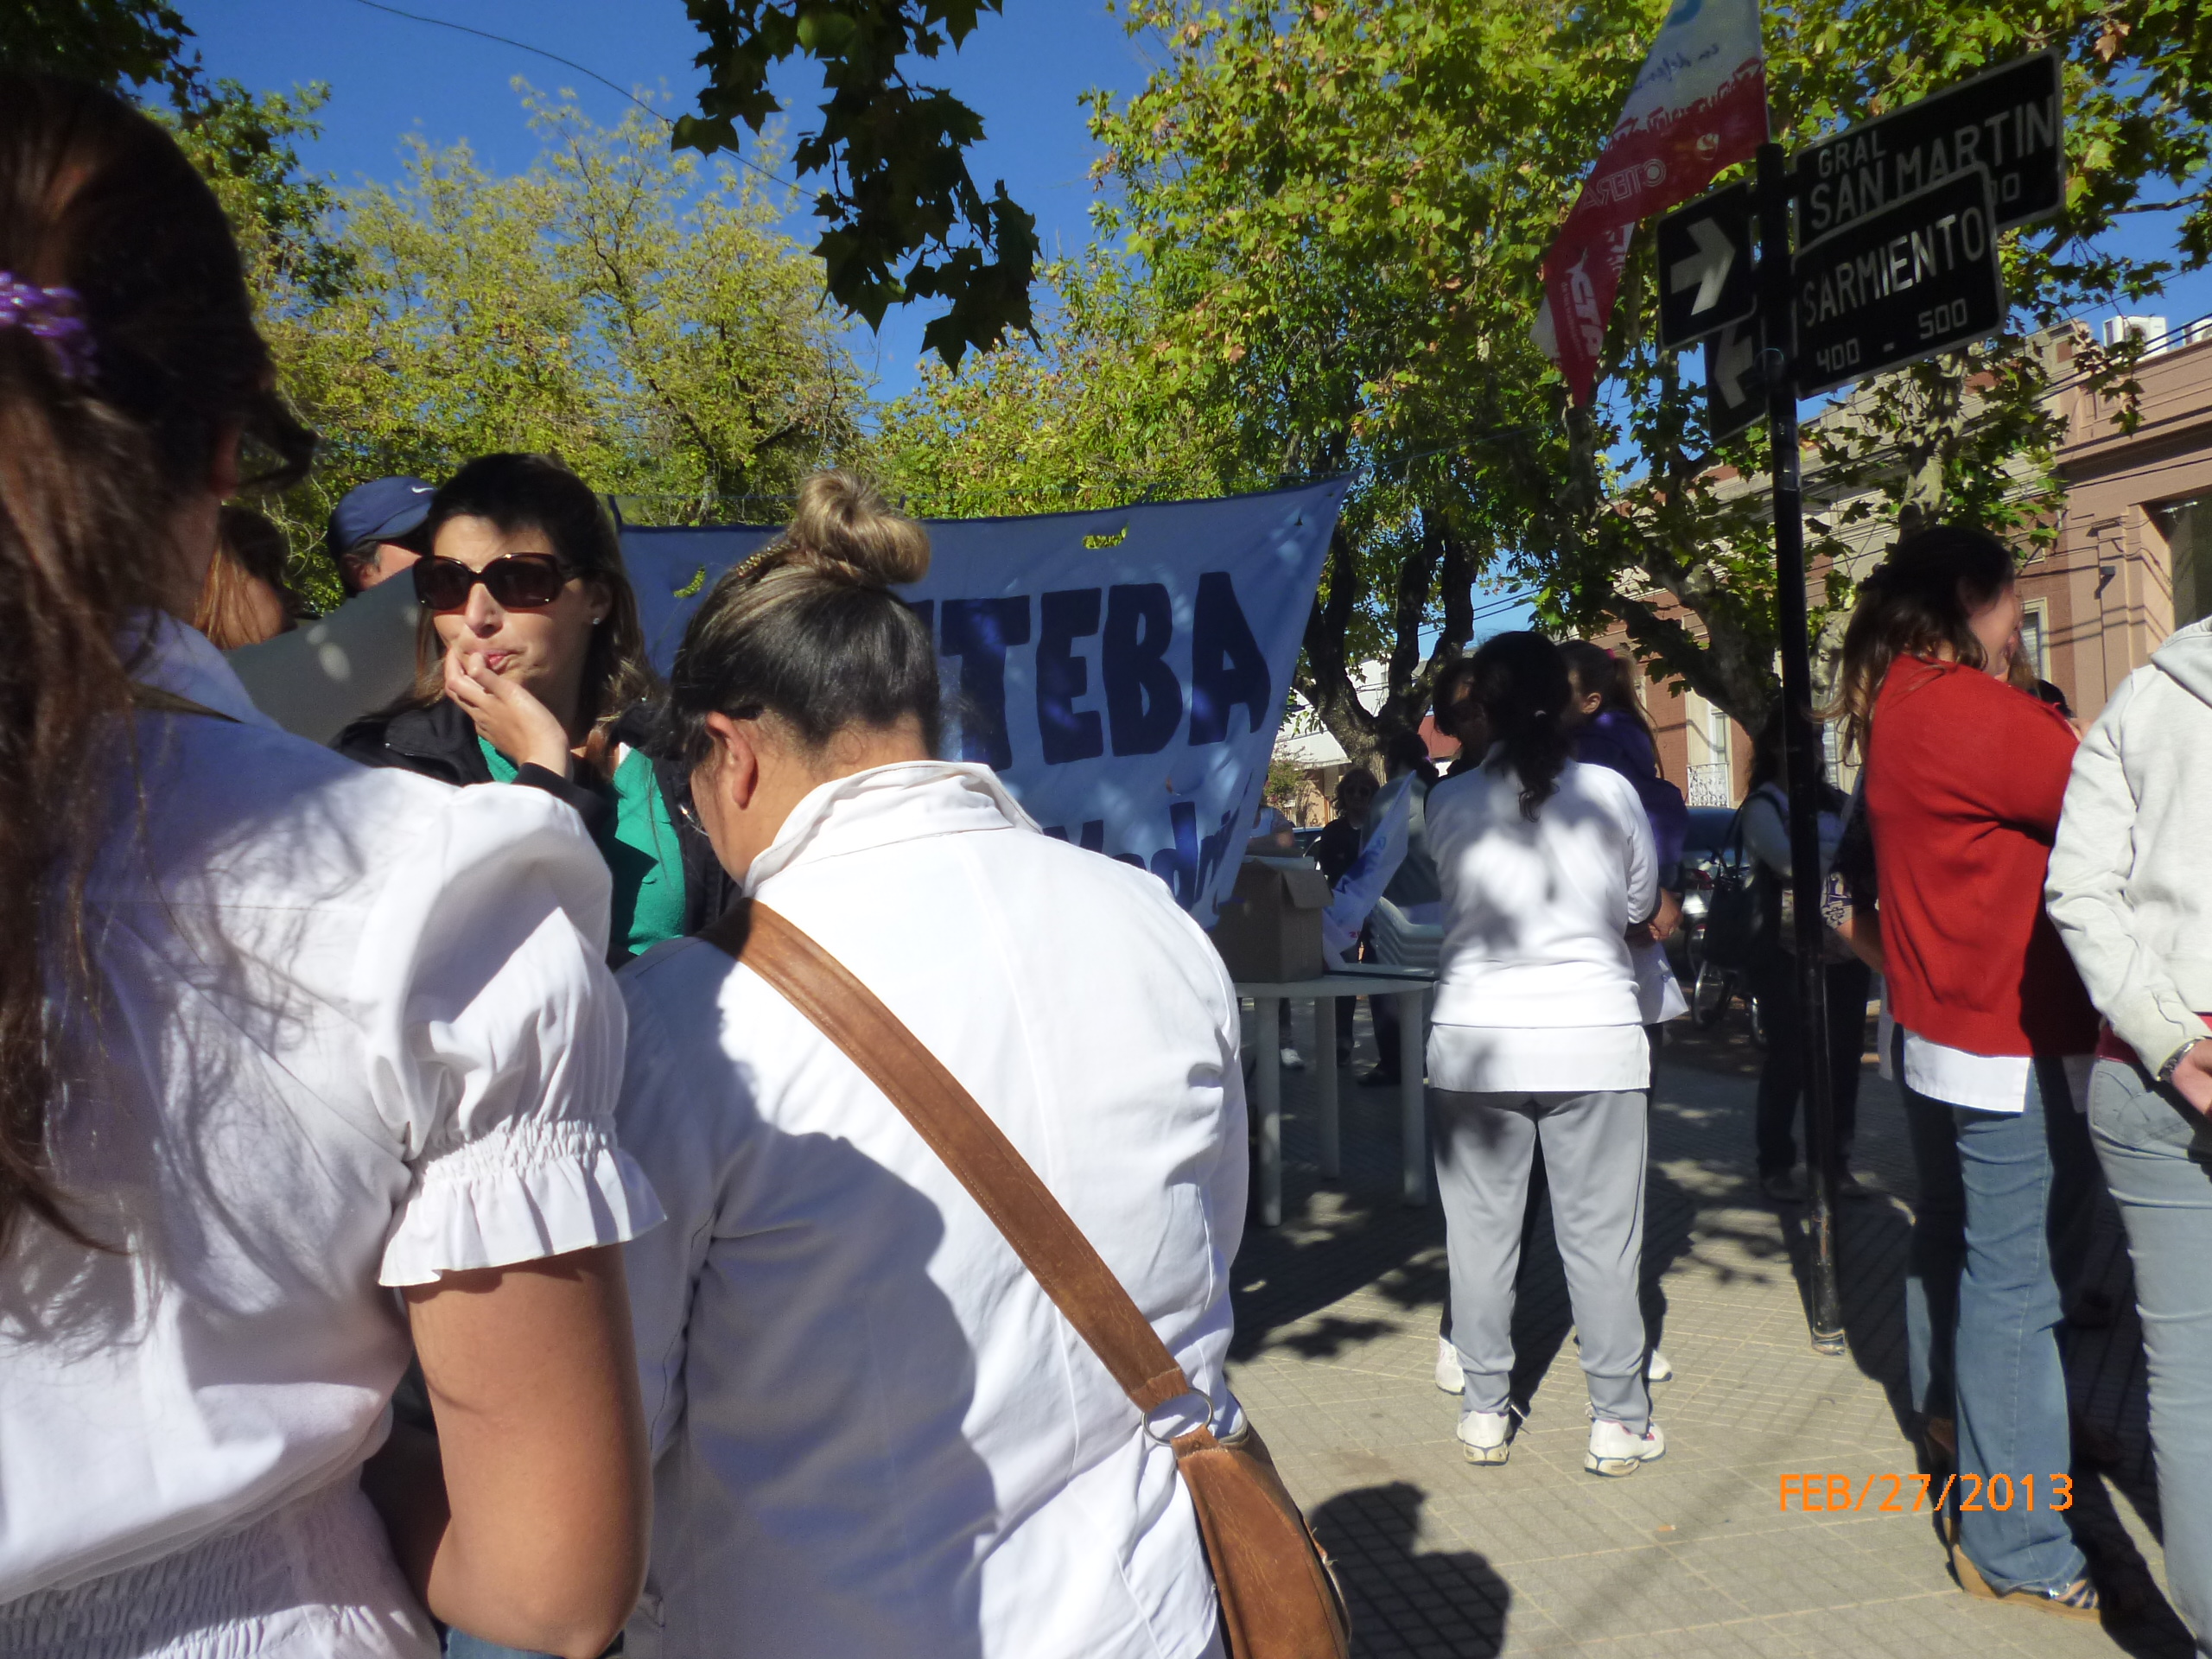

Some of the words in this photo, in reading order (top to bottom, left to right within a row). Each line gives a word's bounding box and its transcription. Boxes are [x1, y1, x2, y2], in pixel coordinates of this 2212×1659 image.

[1811, 160, 1885, 229] SAN
[1896, 94, 2056, 196] MARTIN
[1818, 130, 1887, 178] GRAL
[1803, 207, 1985, 328] SARMIENTO
[1816, 338, 1860, 372] 400
[1919, 298, 1968, 340] 500
[912, 571, 1272, 772] TEBA
